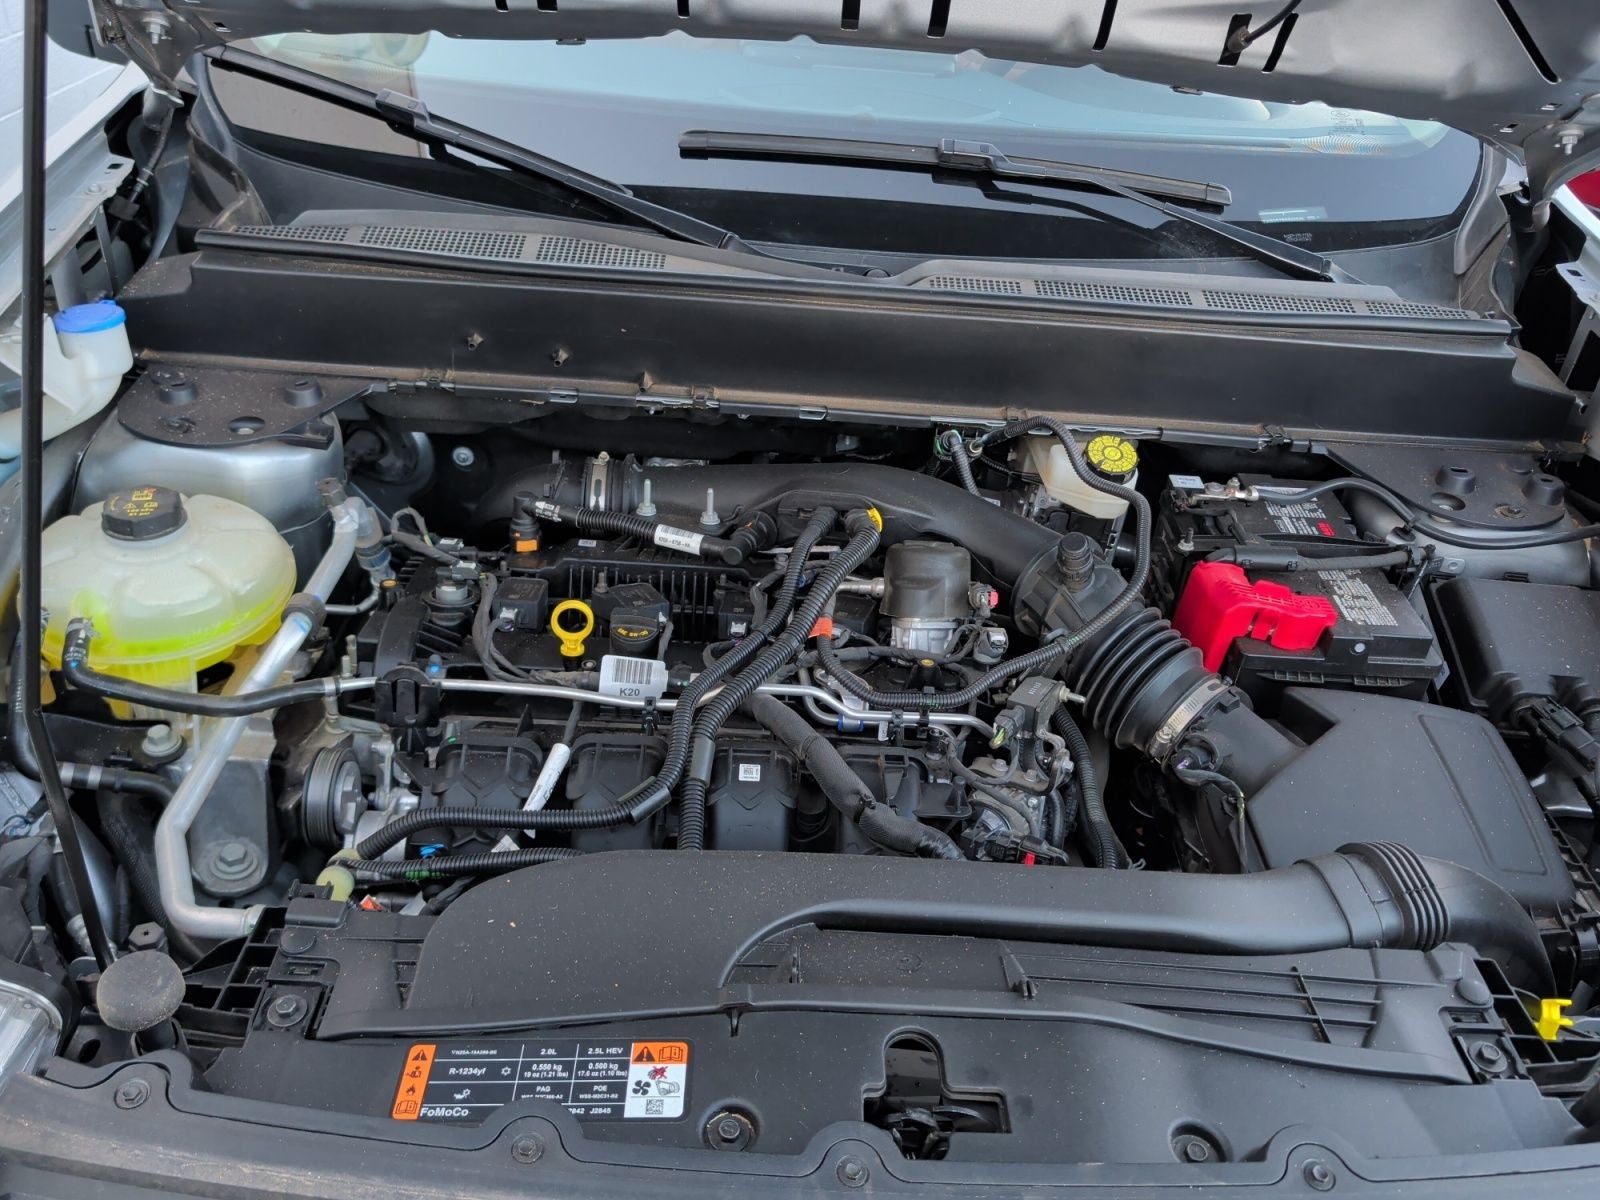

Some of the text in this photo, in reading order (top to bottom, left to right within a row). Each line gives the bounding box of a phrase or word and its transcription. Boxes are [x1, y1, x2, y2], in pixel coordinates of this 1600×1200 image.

[617, 627, 628, 636] SAE
[619, 687, 640, 697] K20
[587, 1047, 604, 1055] 2.5L
[532, 1063, 563, 1072] 0.550 kg
[588, 1062, 619, 1071] 0.500 kg
[448, 1067, 487, 1077] R-1234yf
[540, 1071, 556, 1079] (1.21
[556, 1071, 569, 1079] lbs)
[600, 1070, 615, 1078] (1.10
[615, 1070, 628, 1078] lbs)
[536, 1085, 551, 1093] PAG
[420, 1107, 469, 1117] FoMoCo
